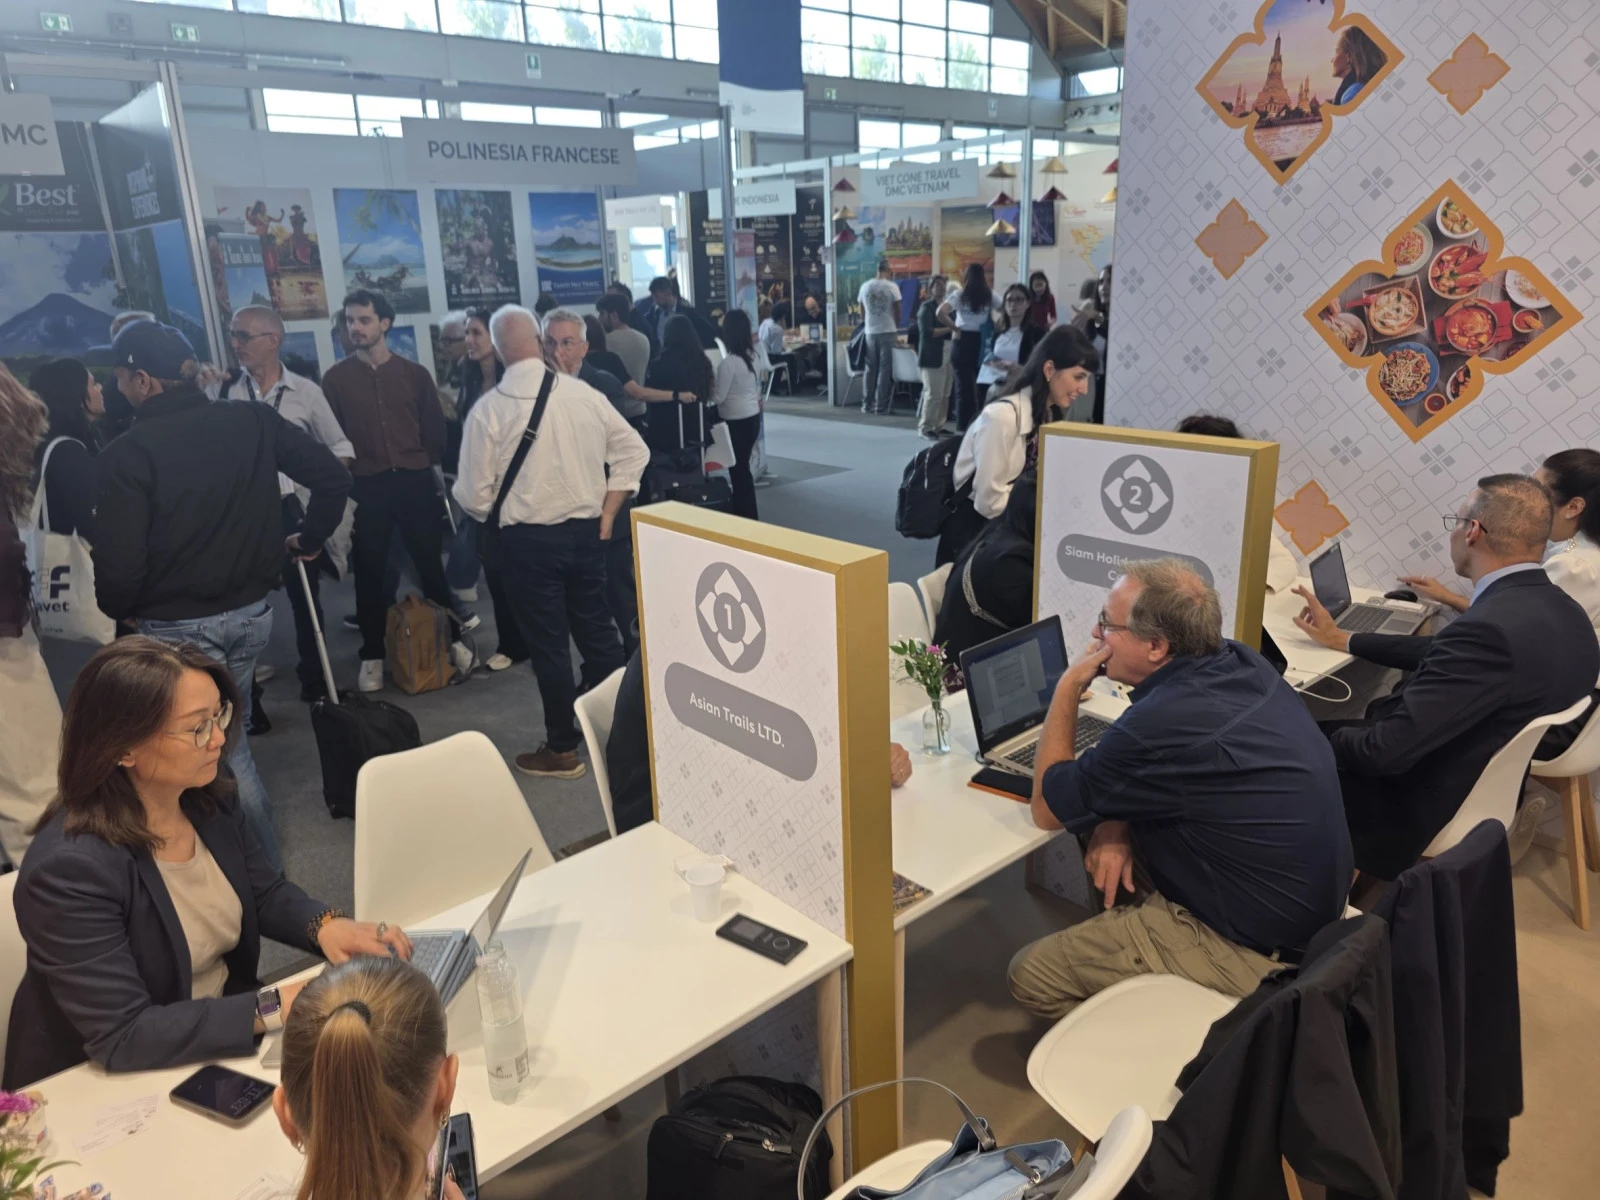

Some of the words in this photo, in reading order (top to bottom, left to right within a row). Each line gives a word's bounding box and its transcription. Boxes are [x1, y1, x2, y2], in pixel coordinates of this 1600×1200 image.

[427, 139, 528, 162] POLINESIA
[531, 144, 621, 165] FRANCESE
[875, 174, 895, 187] VIET
[896, 171, 923, 185] CONE
[924, 167, 961, 181] TRAVEL
[14, 182, 78, 206] Best
[741, 192, 780, 206] INDONESIA
[885, 185, 906, 197] DMC
[907, 181, 950, 195] VIETNAM
[1129, 486, 1142, 505] 2
[1064, 545, 1094, 561] Siam
[1096, 551, 1129, 567] Holid
[724, 603, 733, 630] 1
[689, 691, 721, 718] Asian
[722, 706, 756, 734] Trails
[757, 722, 785, 748] LTD.
